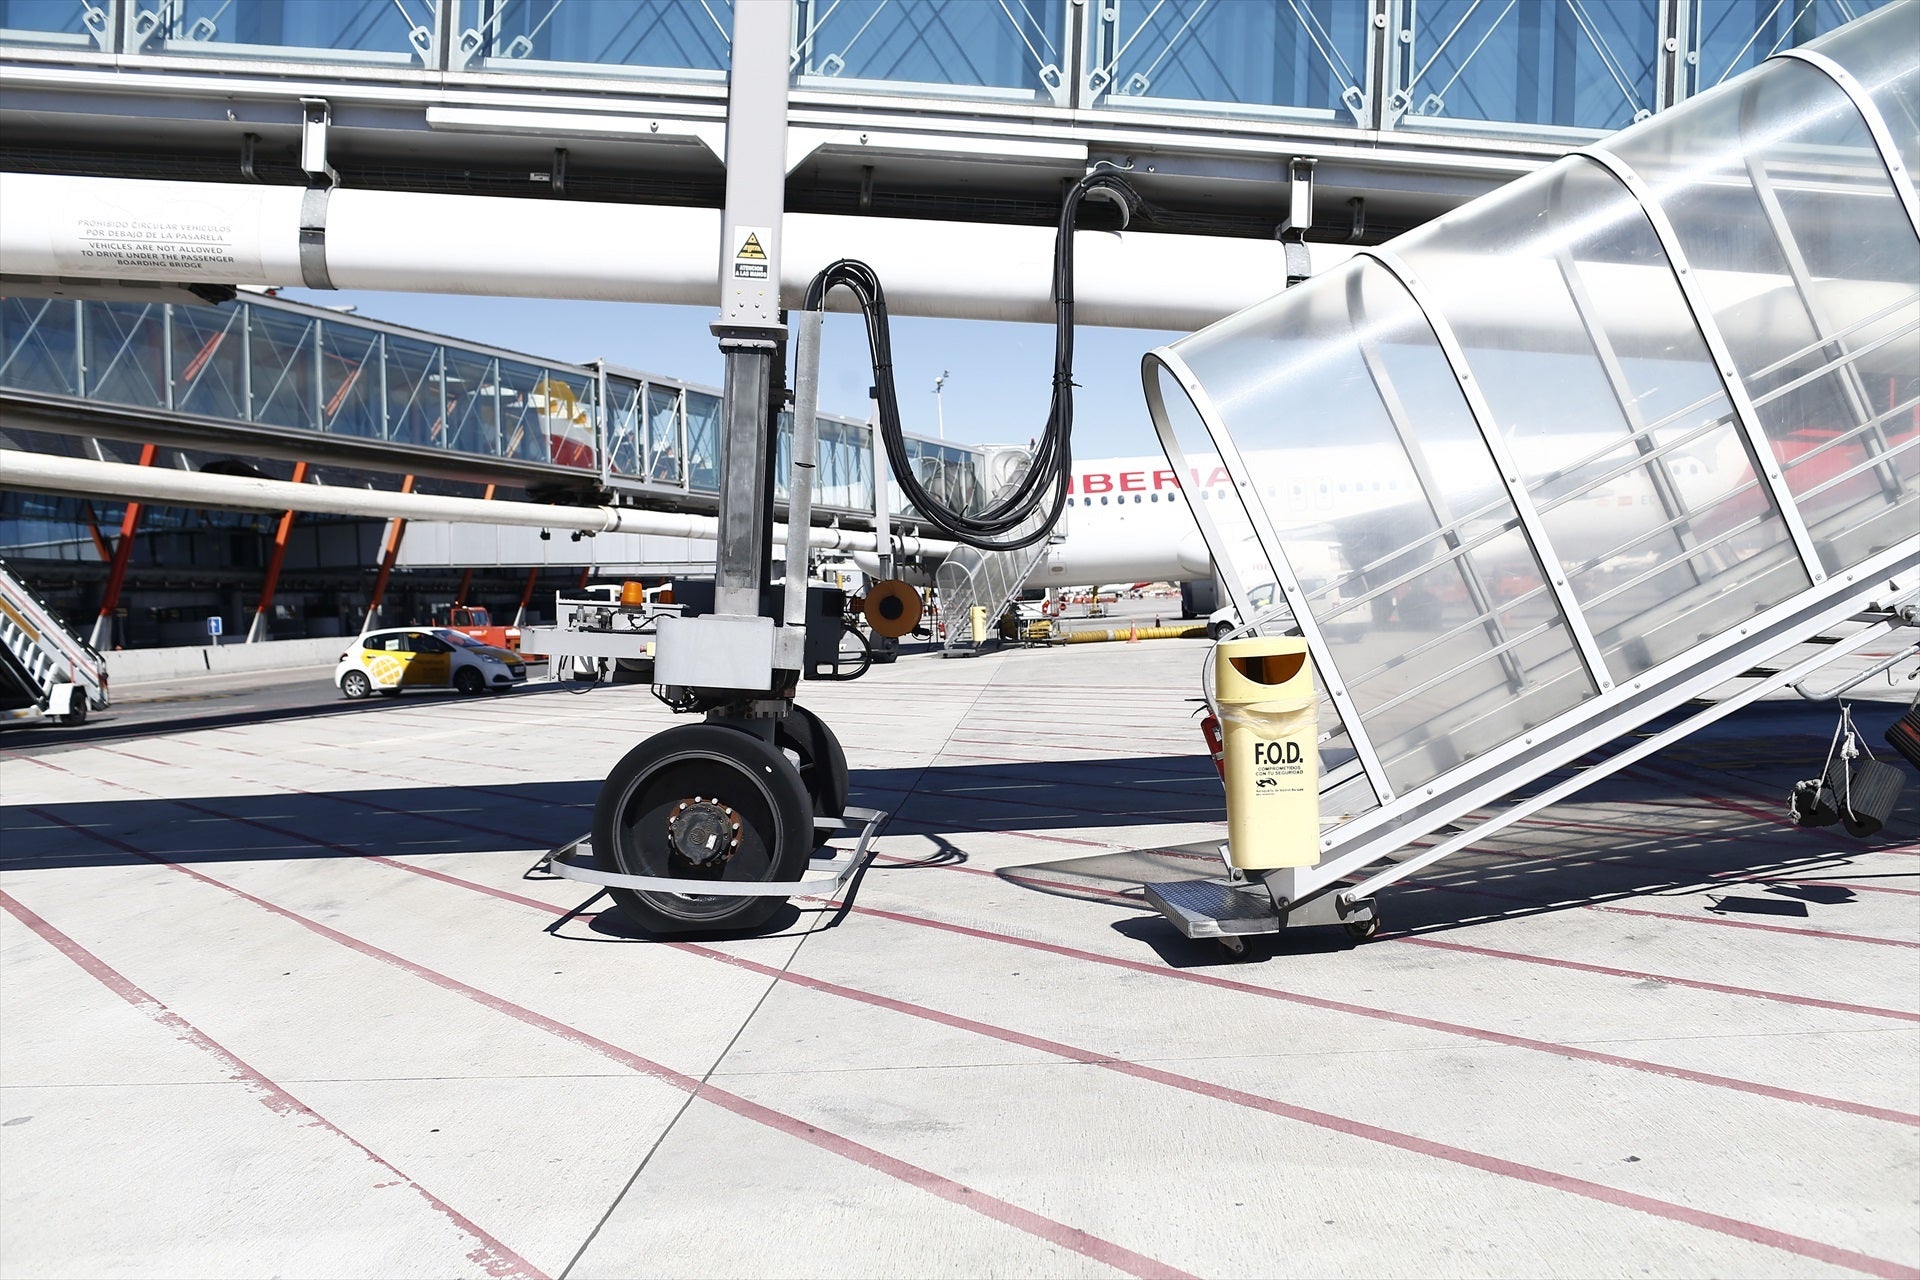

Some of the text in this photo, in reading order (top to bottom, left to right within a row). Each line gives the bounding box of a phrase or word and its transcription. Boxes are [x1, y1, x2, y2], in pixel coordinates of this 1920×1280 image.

[78, 220, 129, 229] PROHIBIDO
[131, 221, 178, 230] CIRCULAR
[108, 230, 143, 238] DEBAJO
[175, 233, 224, 241] PASARELA
[89, 242, 133, 250] VEHICLES
[179, 246, 223, 254] ALLOWED
[181, 254, 234, 263] PASSENGER
[1255, 742, 1303, 765] F.O.D.
